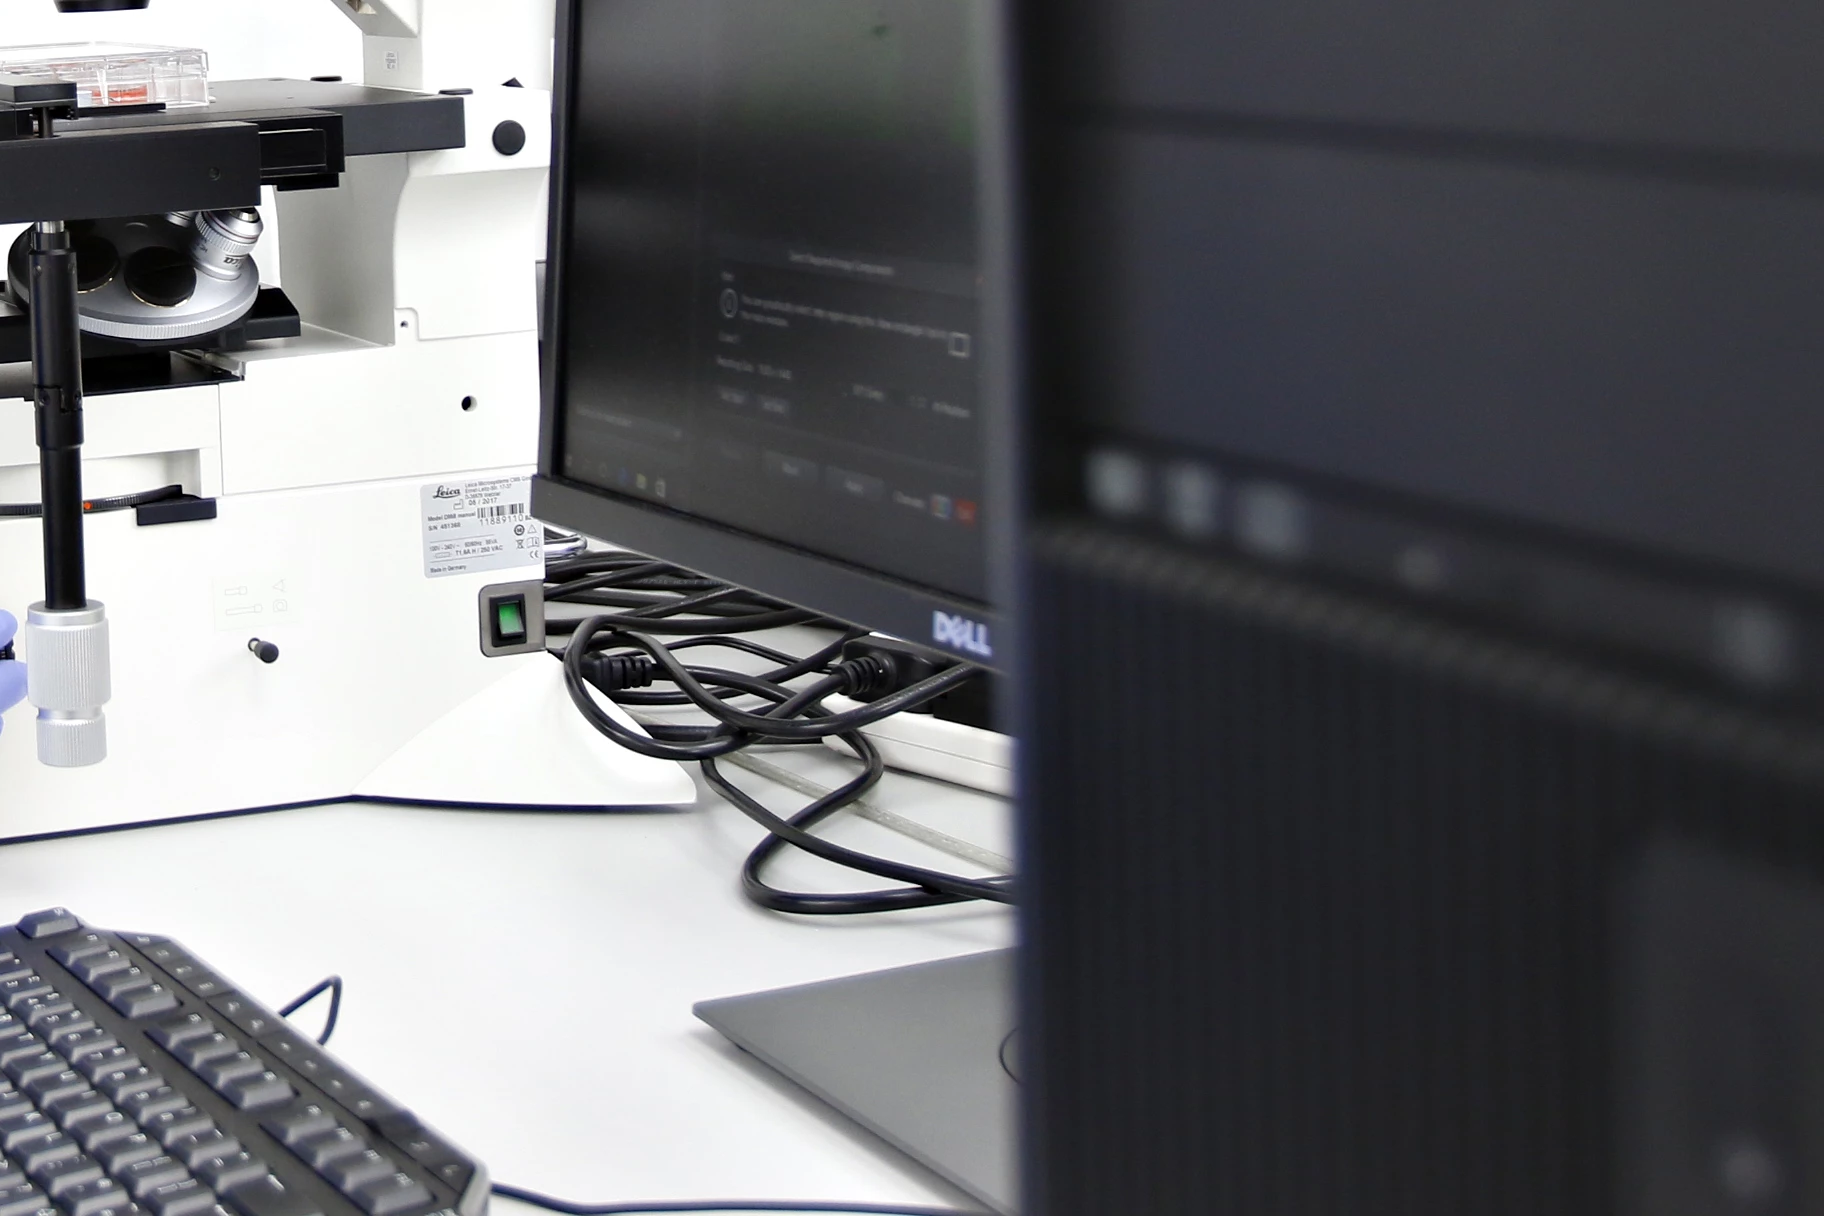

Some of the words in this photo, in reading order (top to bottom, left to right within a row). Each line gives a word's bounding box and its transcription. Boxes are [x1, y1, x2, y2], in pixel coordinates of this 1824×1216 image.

[433, 485, 460, 499] Leica
[480, 514, 523, 526] 11889110
[933, 610, 992, 657] DELL
